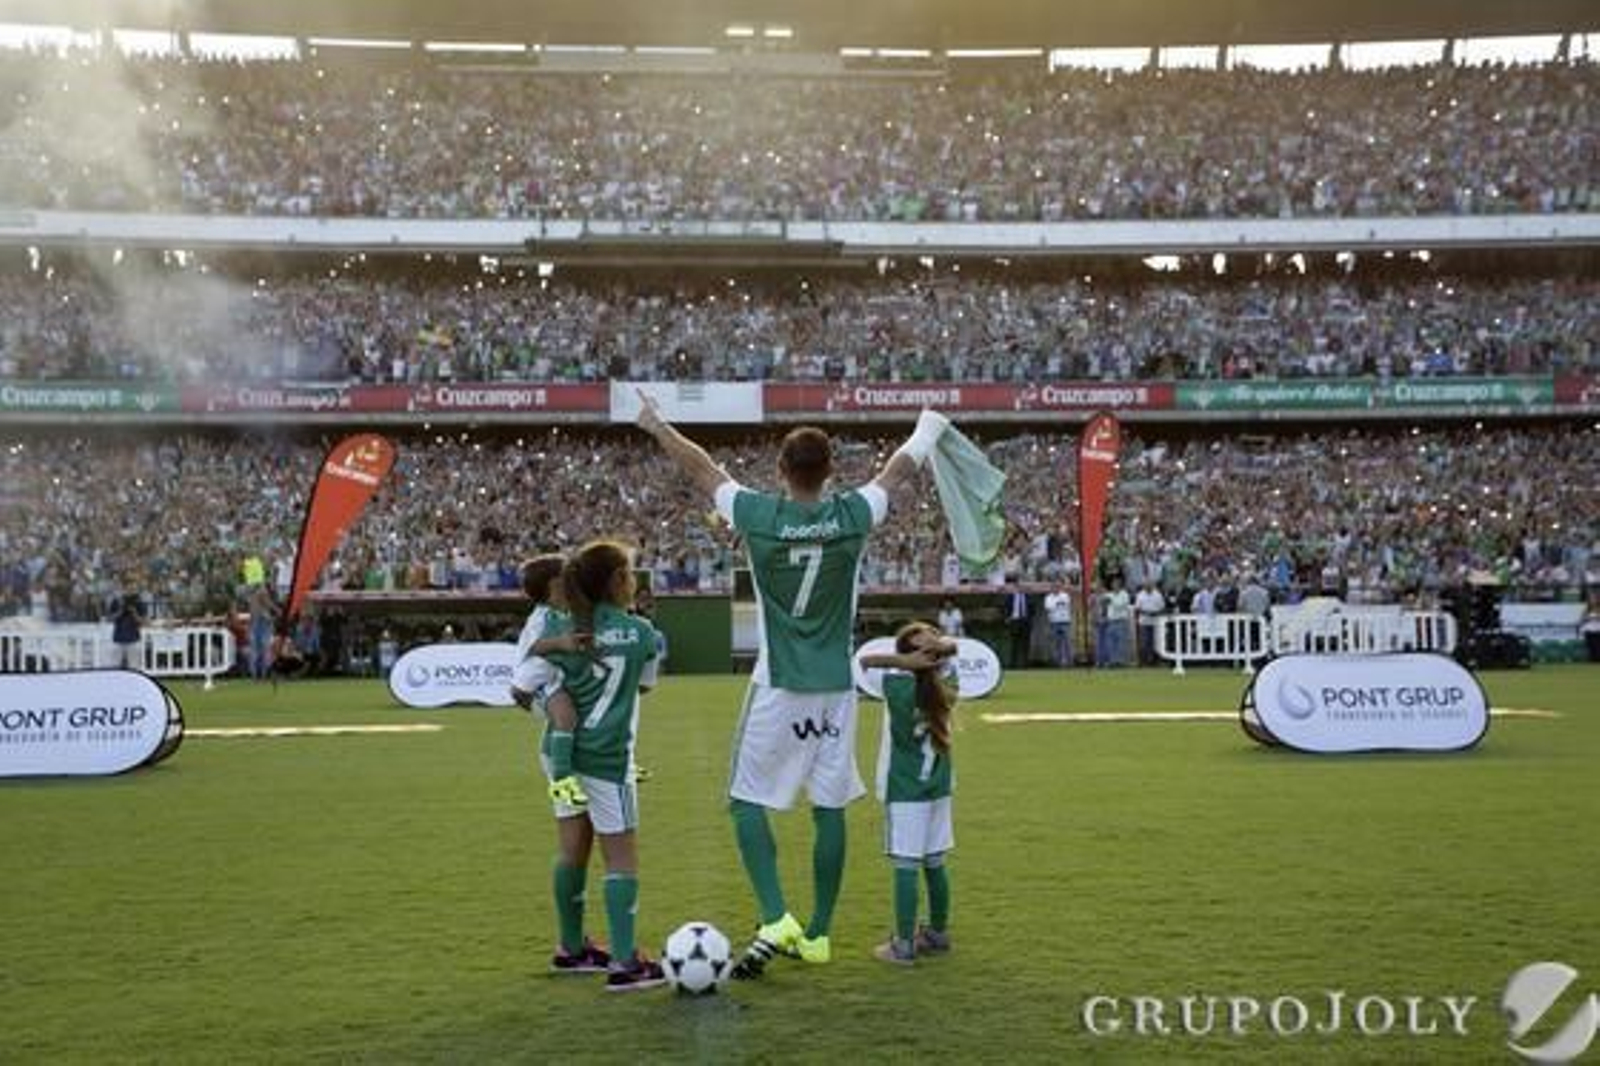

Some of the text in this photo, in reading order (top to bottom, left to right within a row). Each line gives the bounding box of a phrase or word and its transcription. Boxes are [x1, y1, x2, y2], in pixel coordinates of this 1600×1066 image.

[436, 386, 532, 409] Cruzcampo
[855, 386, 945, 411] Cruzcampo
[1041, 384, 1134, 408] Cruzcampo
[789, 547, 823, 618] 7
[583, 655, 627, 729] 7
[1321, 686, 1465, 709] PONT GRUP
[68, 705, 147, 729] GRUP
